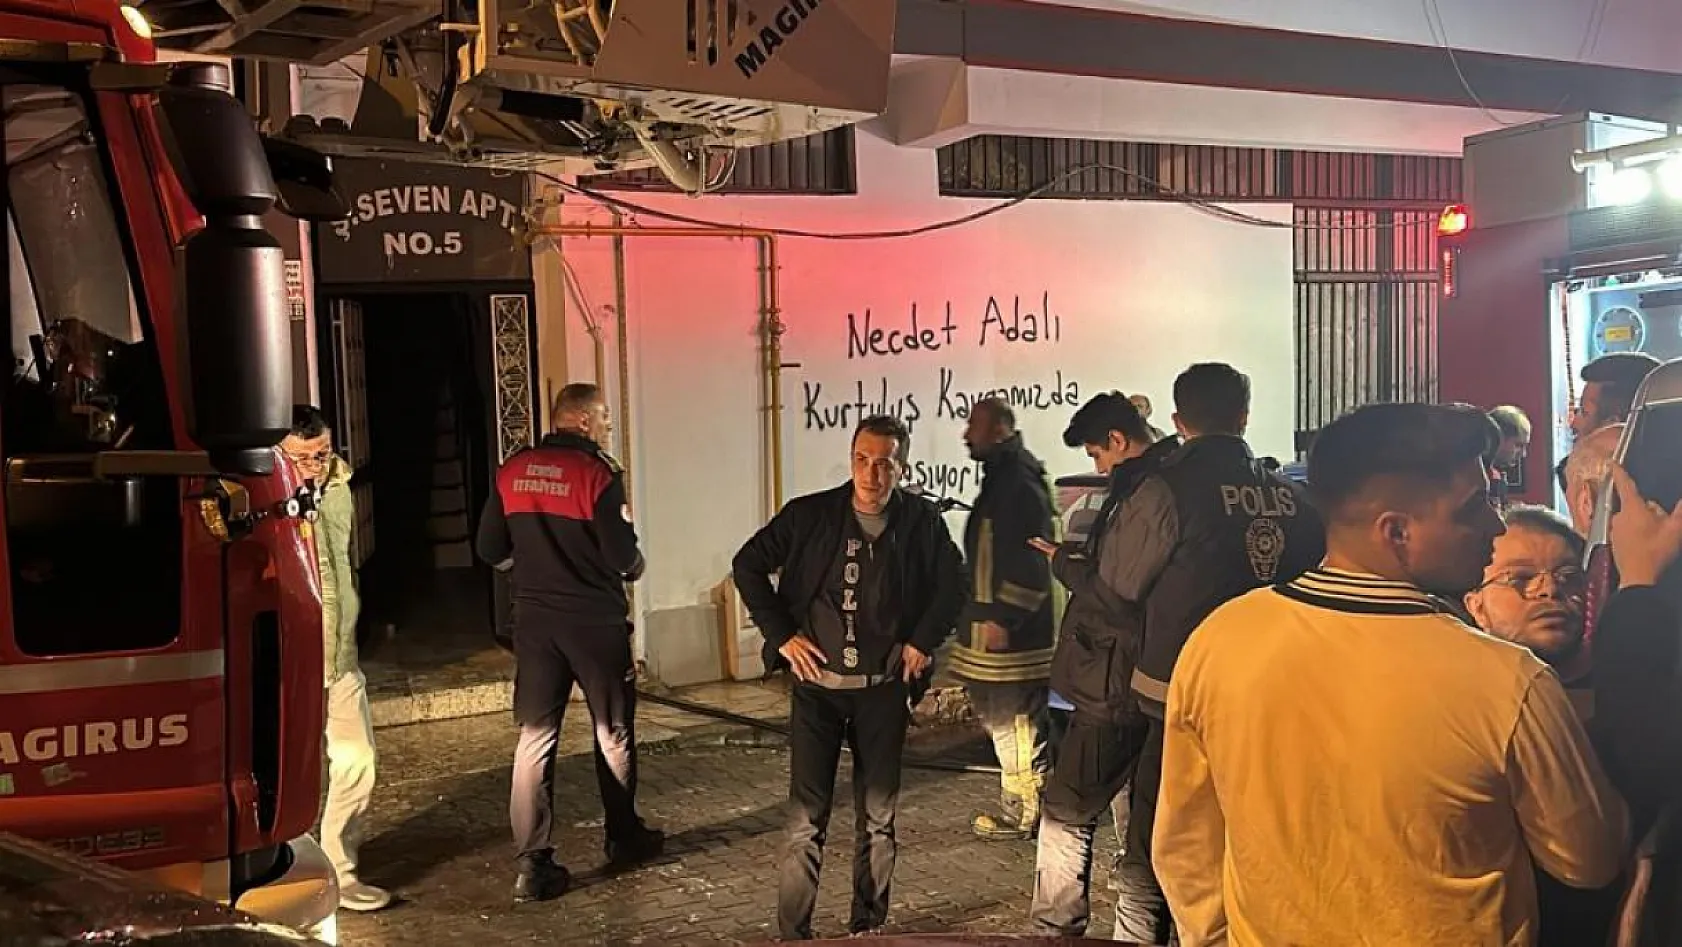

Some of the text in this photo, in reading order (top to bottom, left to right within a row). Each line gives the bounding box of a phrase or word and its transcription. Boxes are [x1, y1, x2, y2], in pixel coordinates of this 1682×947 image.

[383, 231, 463, 255] NO.5
[847, 290, 1060, 359] Necdet Adalı
